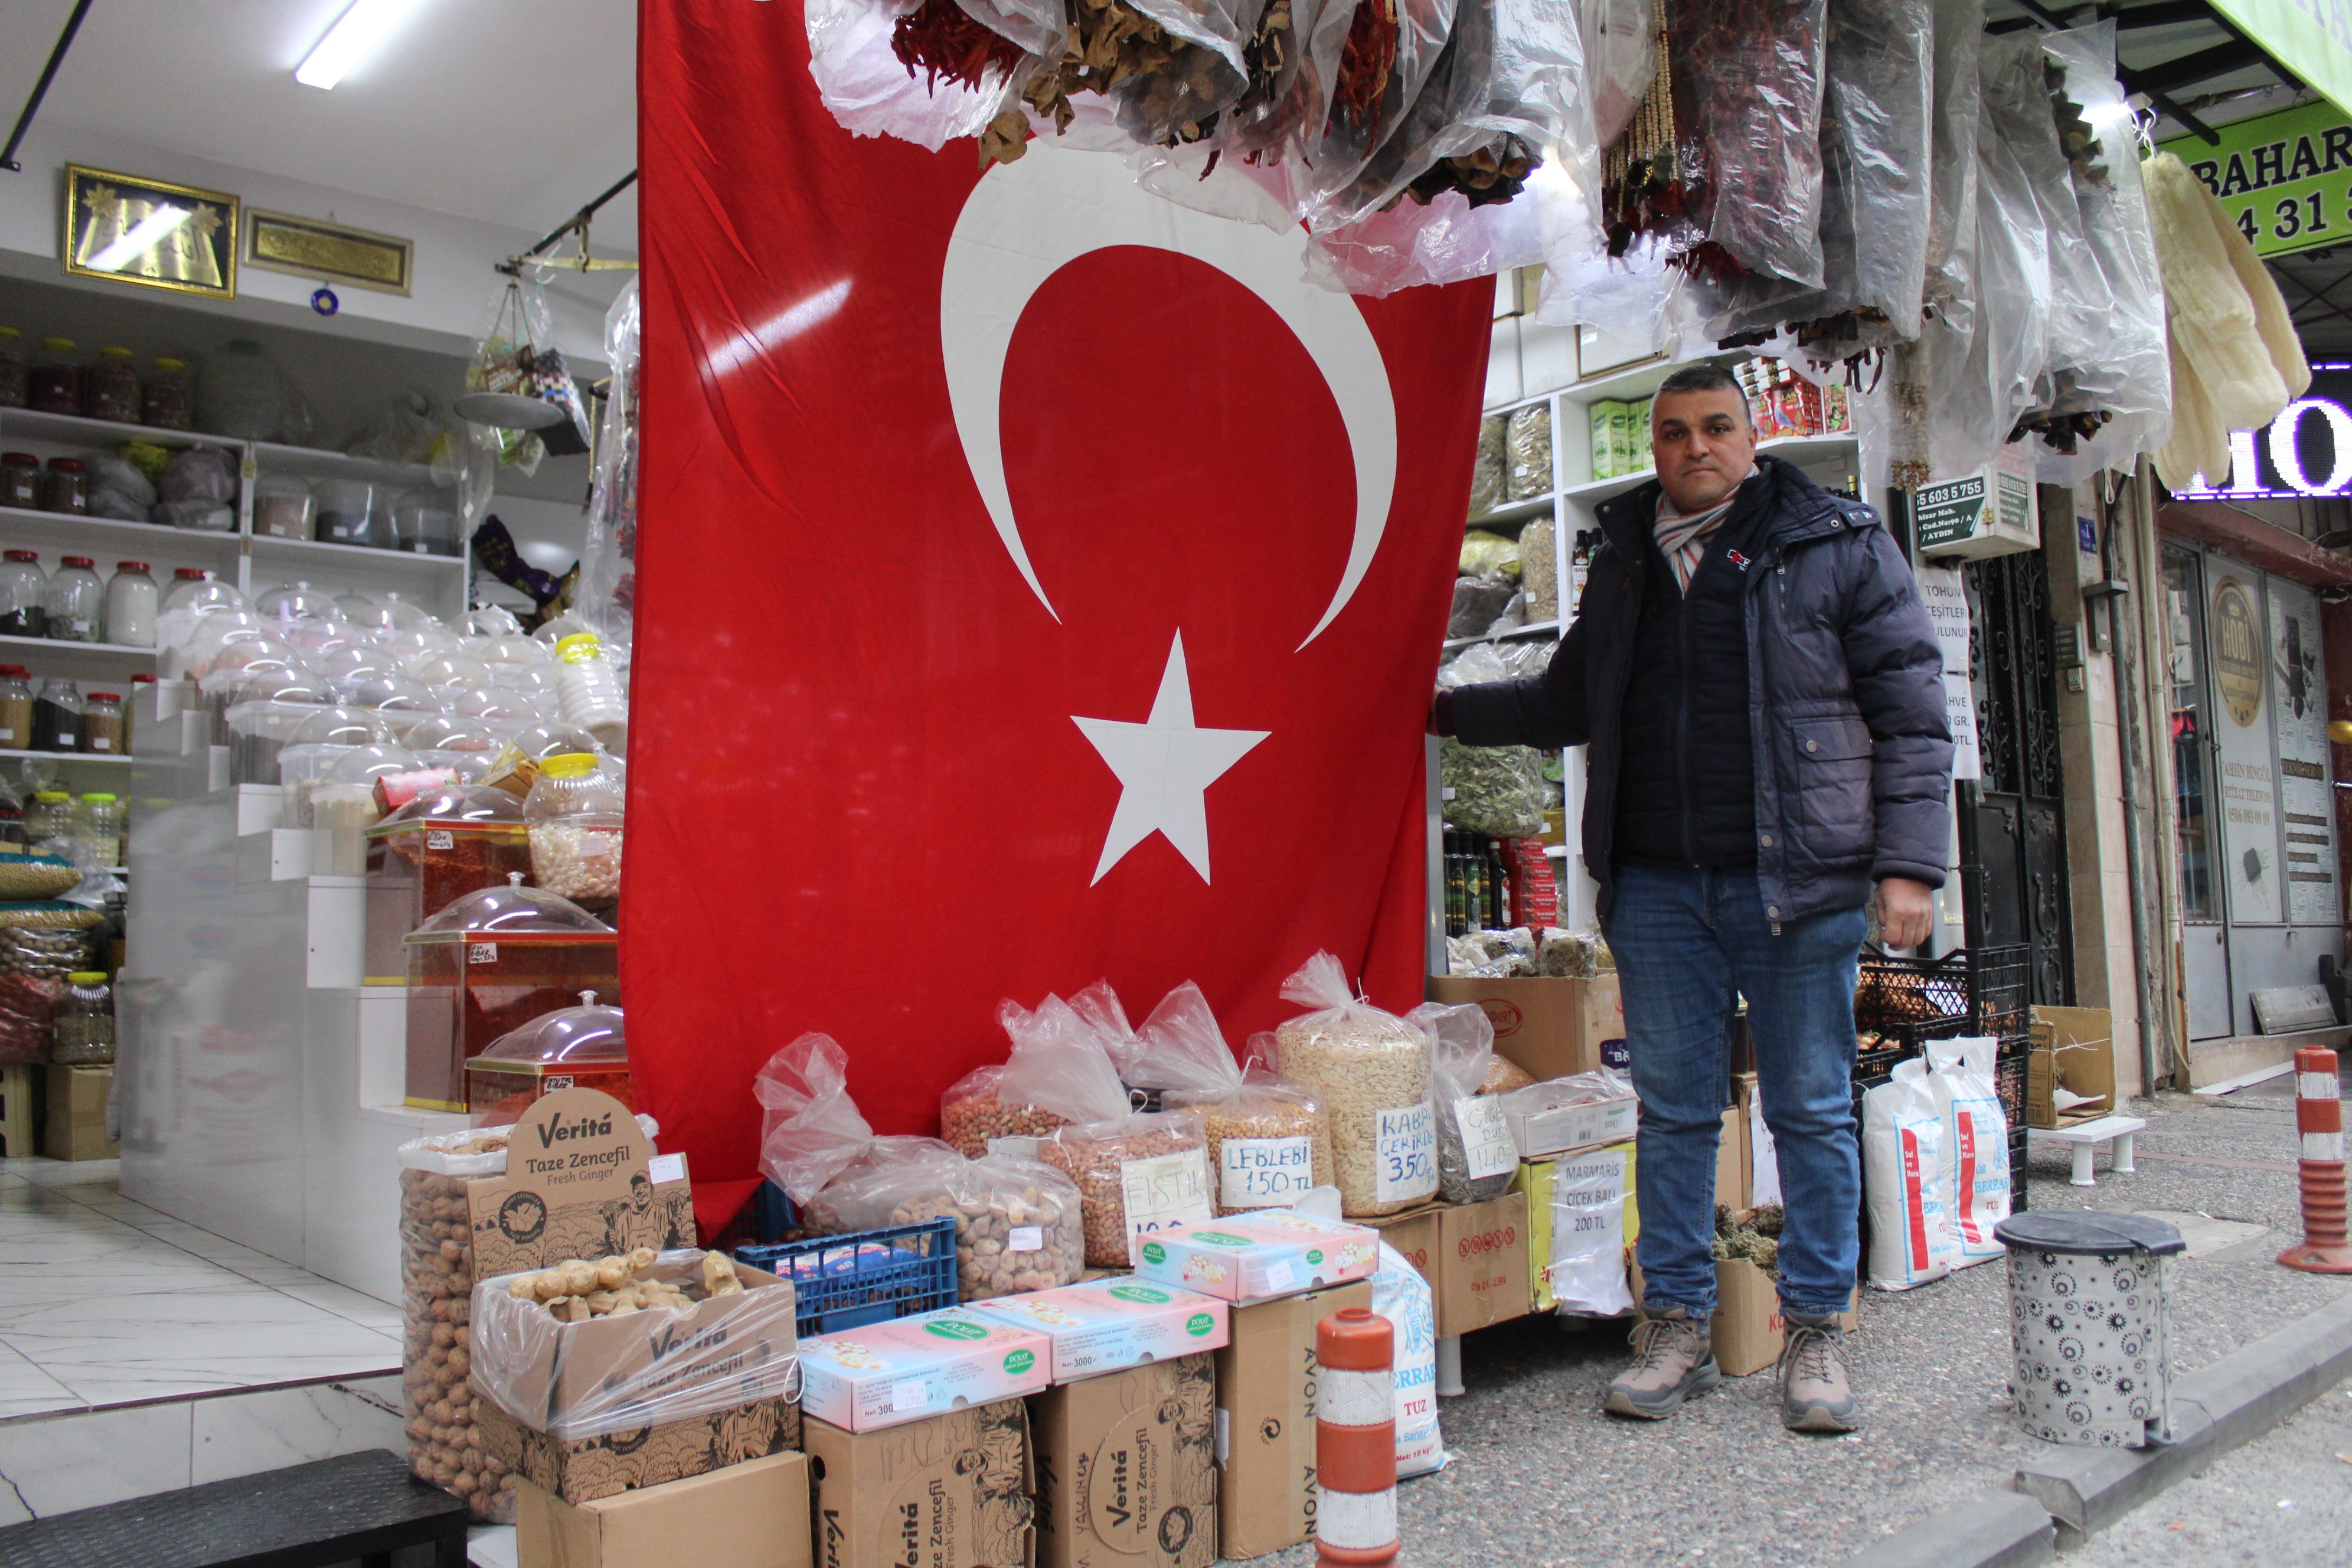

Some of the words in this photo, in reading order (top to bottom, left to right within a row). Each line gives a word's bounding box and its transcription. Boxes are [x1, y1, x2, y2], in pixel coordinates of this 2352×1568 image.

[2275, 191, 2327, 239] 31
[1928, 489, 1949, 504] 603
[1951, 486, 1958, 499] 5
[1959, 481, 1981, 497] 755
[1938, 508, 1956, 517] Mah.
[1922, 518, 1959, 531] Cad.No:90
[1928, 528, 1954, 540] AYDIN
[2221, 615, 2251, 663] HOBİ
[1954, 716, 1970, 727] GR.
[2246, 763, 2271, 782] BİNGÖL
[2228, 807, 2242, 822] 0506
[2244, 809, 2253, 825] 093
[2255, 811, 2262, 825] 09
[2262, 811, 2269, 825] 09
[526, 1155, 564, 1174] Taze
[569, 1145, 631, 1170] Zencefil
[1228, 1141, 1307, 1170] LEBLEBİ
[1389, 1152, 1427, 1182] 350
[1566, 1160, 1619, 1180] MARMARİS
[1907, 1170, 1919, 1178] Kuru
[1976, 1163, 1986, 1174] ÖZ
[546, 1171, 576, 1186] Fresh
[579, 1168, 613, 1182] Ginger
[1246, 1171, 1289, 1195] 150
[1293, 1177, 1312, 1191] TL
[1126, 1170, 1204, 1213] FISTIK
[1574, 1217, 1592, 1231] 200
[1595, 1216, 1605, 1229] TL
[1146, 1246, 1162, 1255] POLAT
[1471, 1281, 1481, 1292] Kg
[1482, 1280, 1489, 1290] 10
[1492, 1275, 1507, 1288] NET:
[1191, 1315, 1210, 1325] POLAT
[681, 1351, 743, 1378] Zencefil
[1008, 1351, 1029, 1363] POLAT
[1074, 1355, 1092, 1368] 3000
[894, 1373, 919, 1383] HAYVANCILIK
[919, 1368, 940, 1376] BAKANLIĞI
[1304, 1347, 1317, 1419] AVON
[1404, 1399, 1427, 1416] TUZ
[1136, 1427, 1151, 1491] Zencefil
[1149, 1442, 1159, 1482] Ginger
[1396, 1453, 1411, 1463] Net:
[1413, 1450, 1421, 1458] 10
[1422, 1446, 1430, 1457] kg
[1149, 1483, 1158, 1511] Fresh
[1304, 1465, 1317, 1536] AVON
[929, 1478, 946, 1548] Zencefil
[945, 1496, 958, 1530] Ginger
[1136, 1496, 1148, 1534] Taze
[945, 1531, 956, 1568] Fresh
